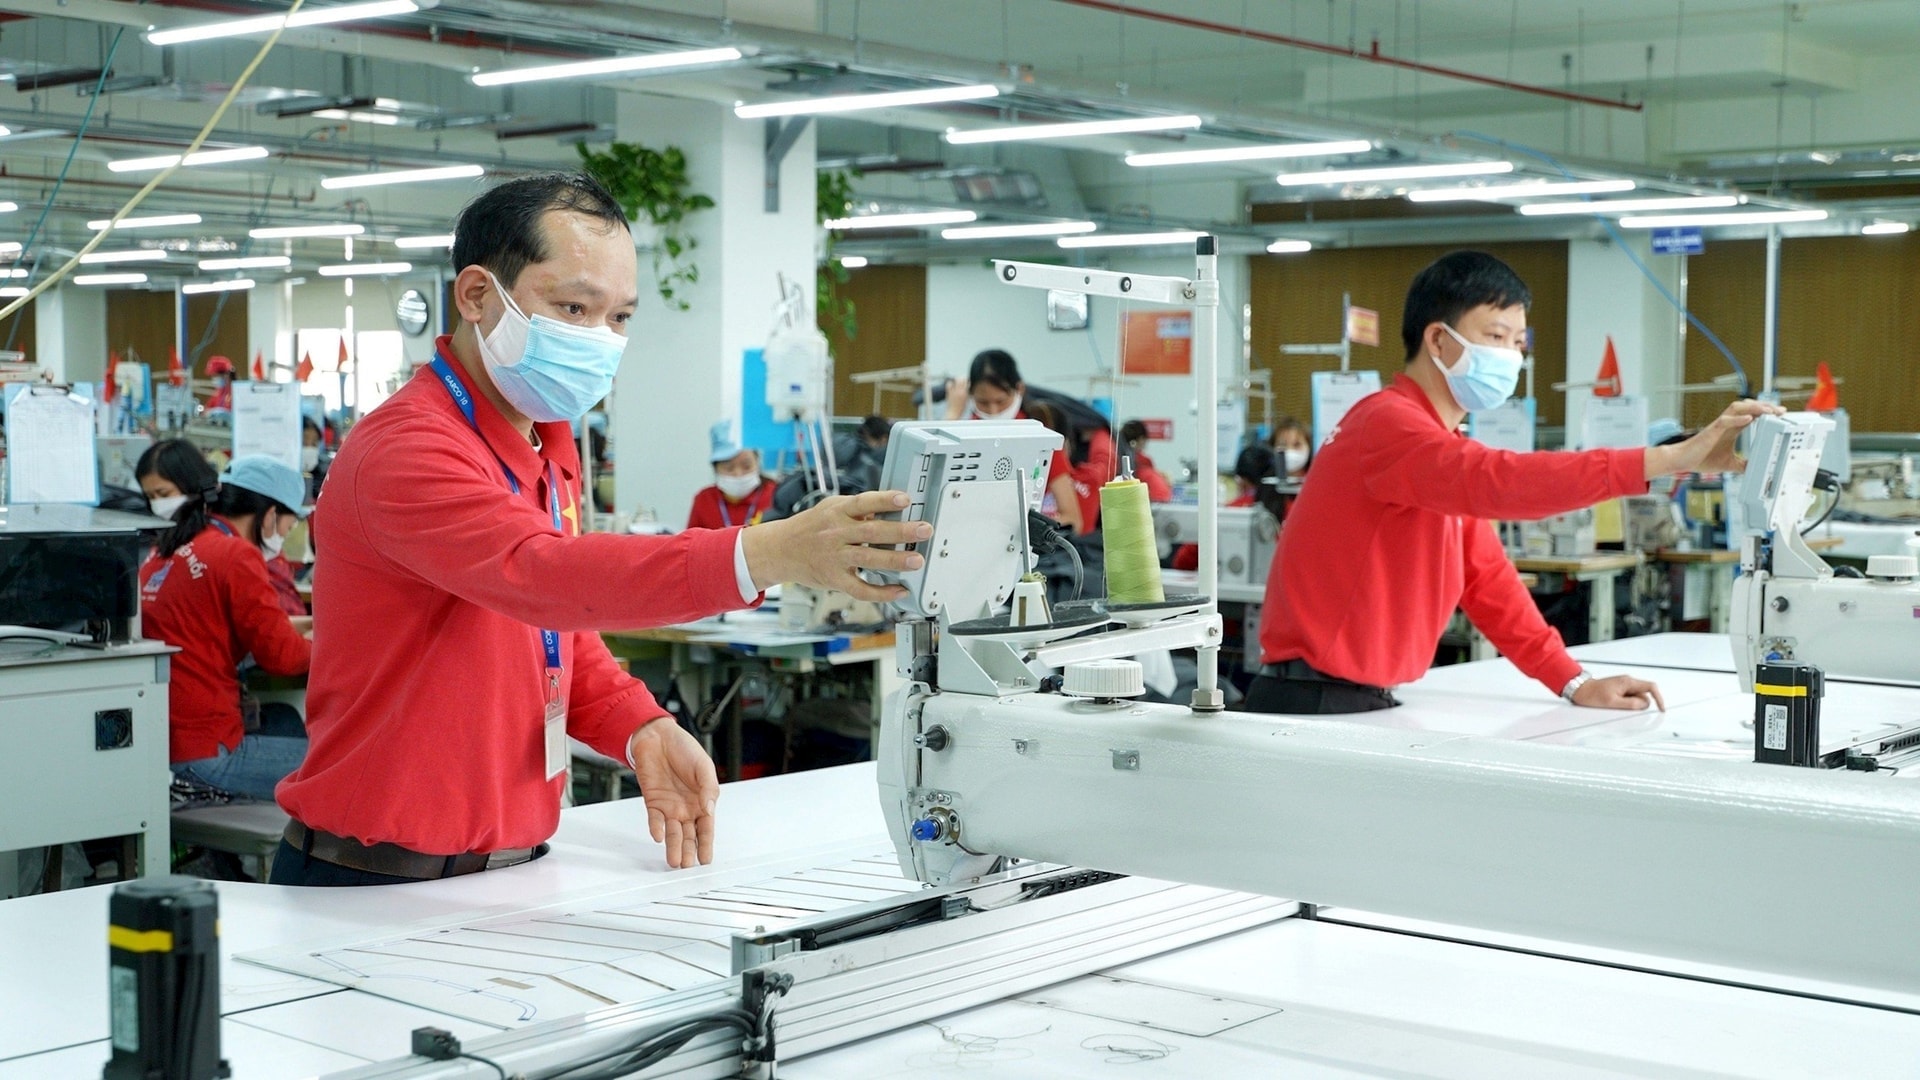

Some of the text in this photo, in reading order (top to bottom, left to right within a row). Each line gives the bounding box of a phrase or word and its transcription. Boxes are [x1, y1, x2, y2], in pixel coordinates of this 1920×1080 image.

[445, 375, 468, 406] GARCO 10
[548, 646, 555, 654] 10
